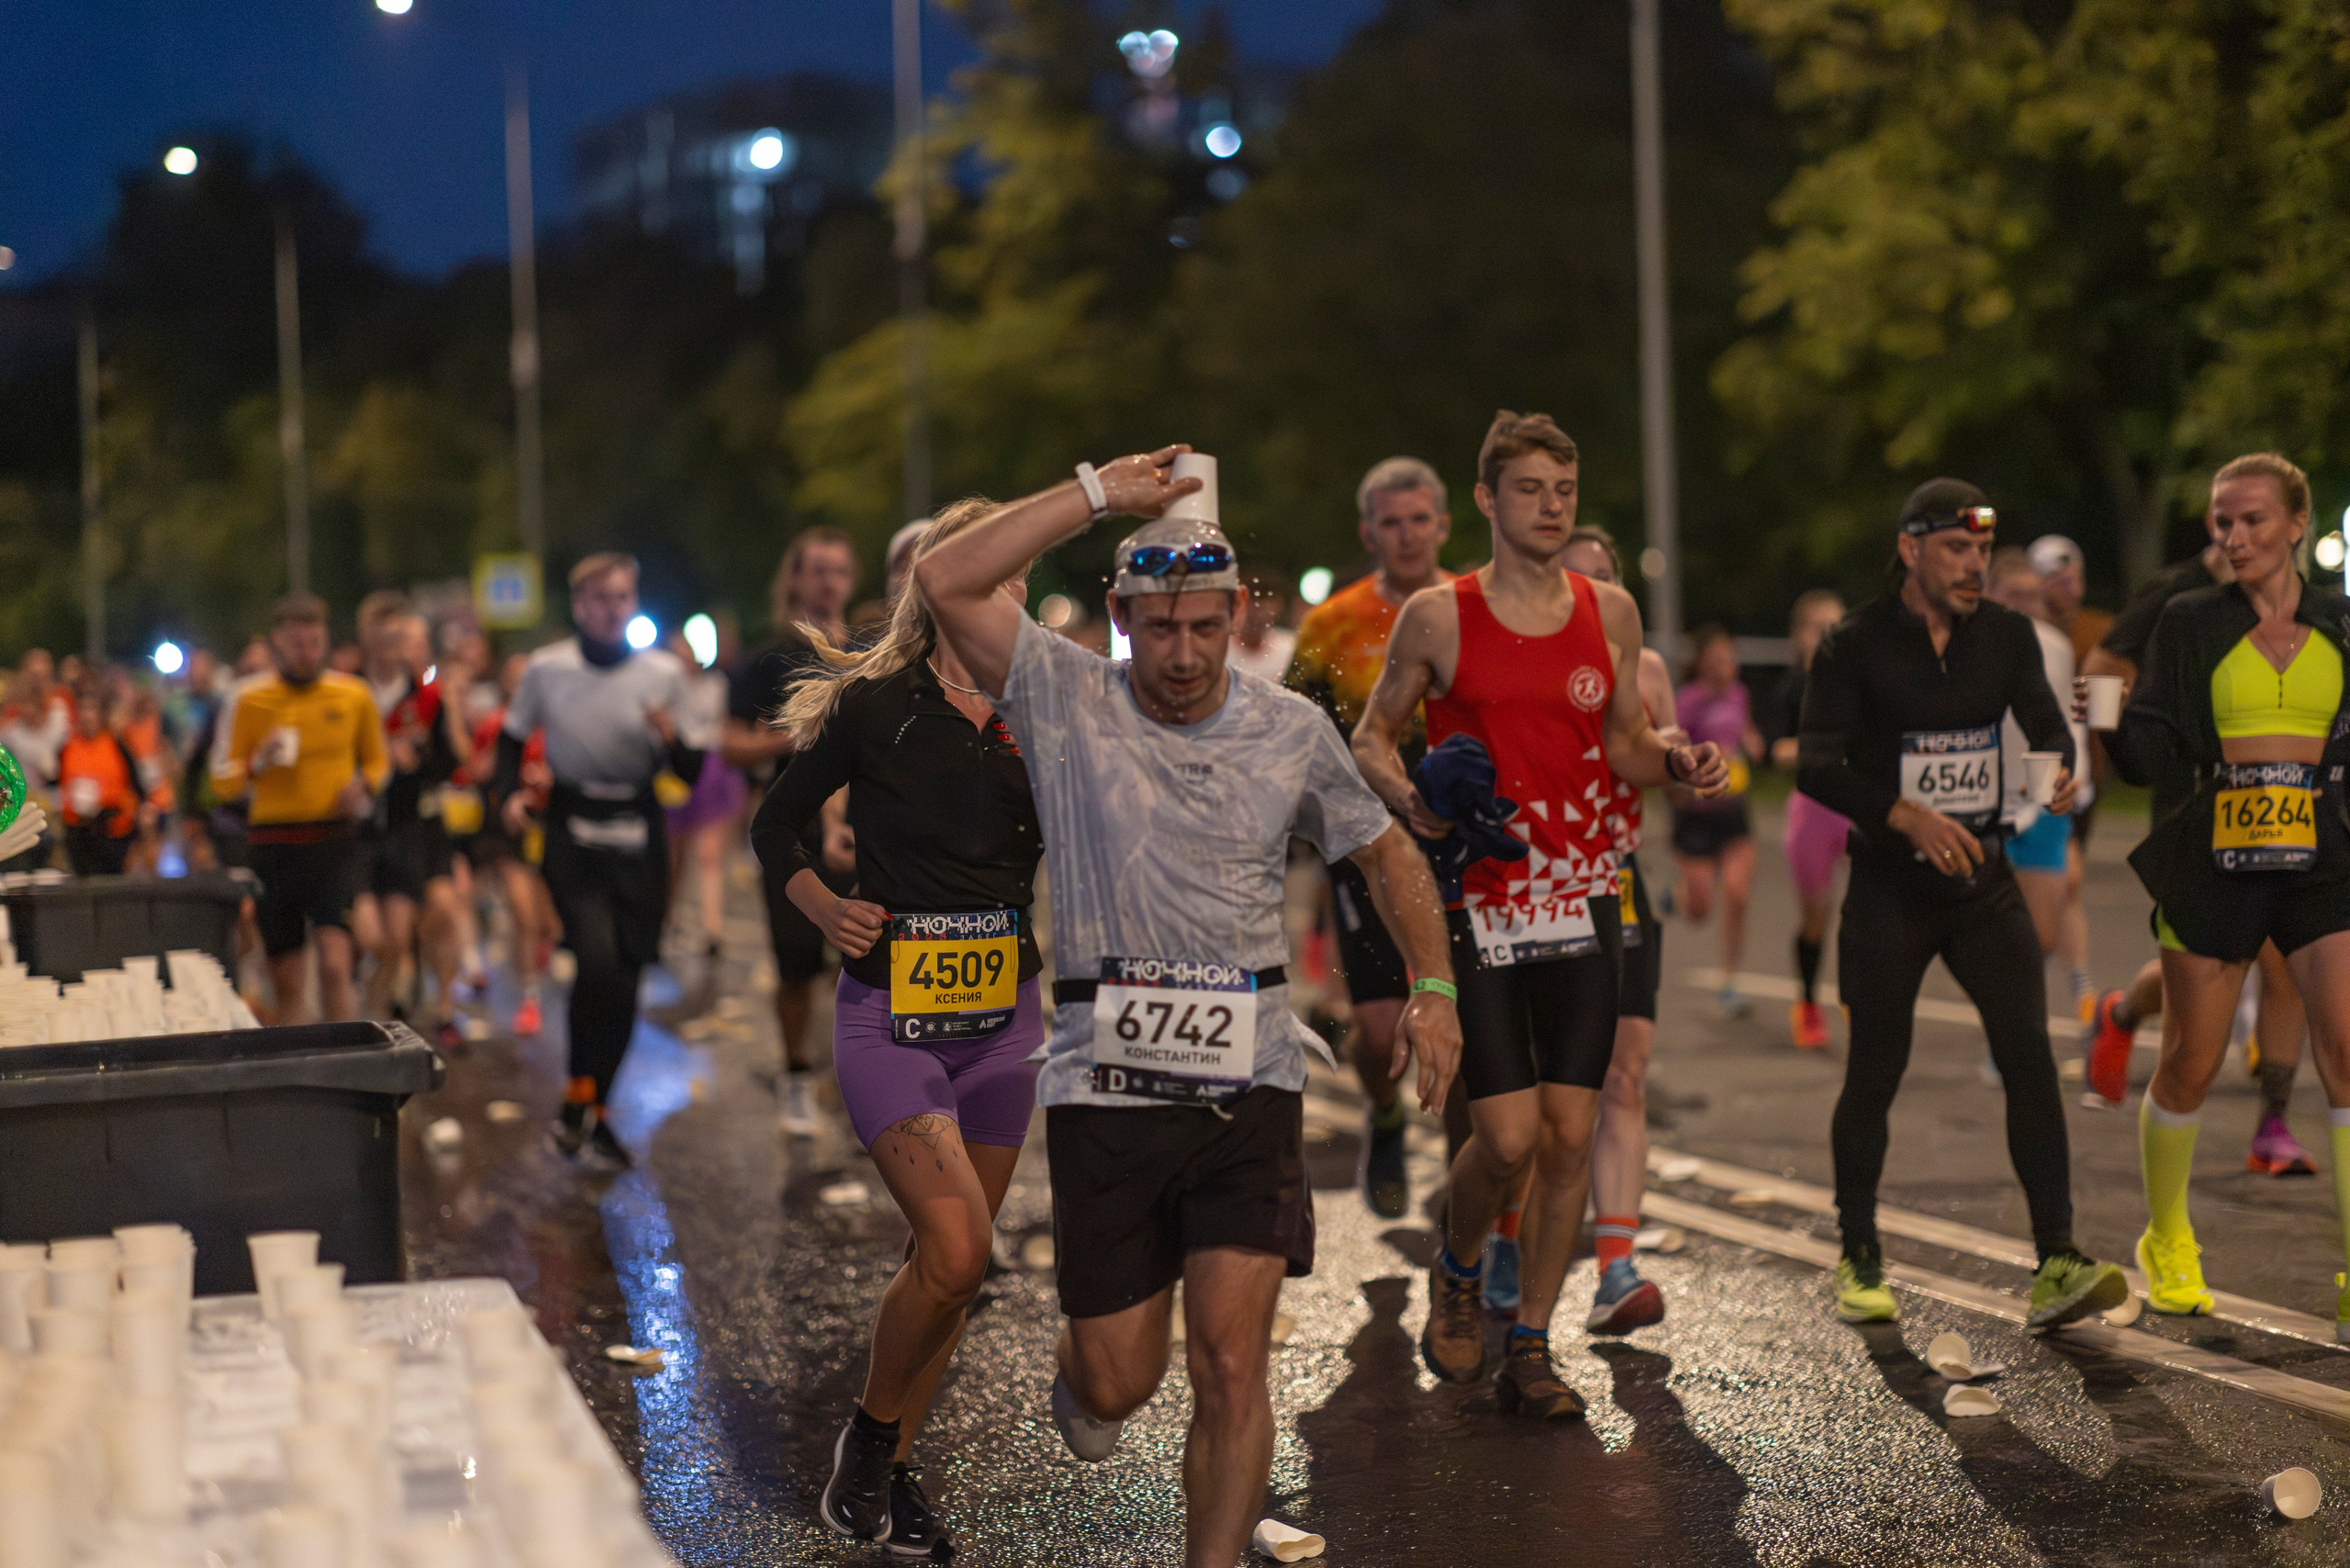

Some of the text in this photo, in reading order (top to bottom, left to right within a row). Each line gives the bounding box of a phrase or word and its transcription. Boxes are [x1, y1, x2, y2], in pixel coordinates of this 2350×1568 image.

[1918, 759, 1990, 794] 6546
[2221, 796, 2311, 829] 16264
[907, 911, 1009, 934] НОЧНОЙ
[898, 933, 947, 941] 2025
[909, 949, 1004, 990] 4509
[1117, 958, 1245, 986] НОЧНОЙ
[934, 991, 981, 1004] КСЕНИЯ
[905, 1018, 921, 1039] C
[1116, 1000, 1231, 1048] 6742
[1125, 1046, 1221, 1065] КОНСТАНТИН
[1109, 1069, 1126, 1092] D
